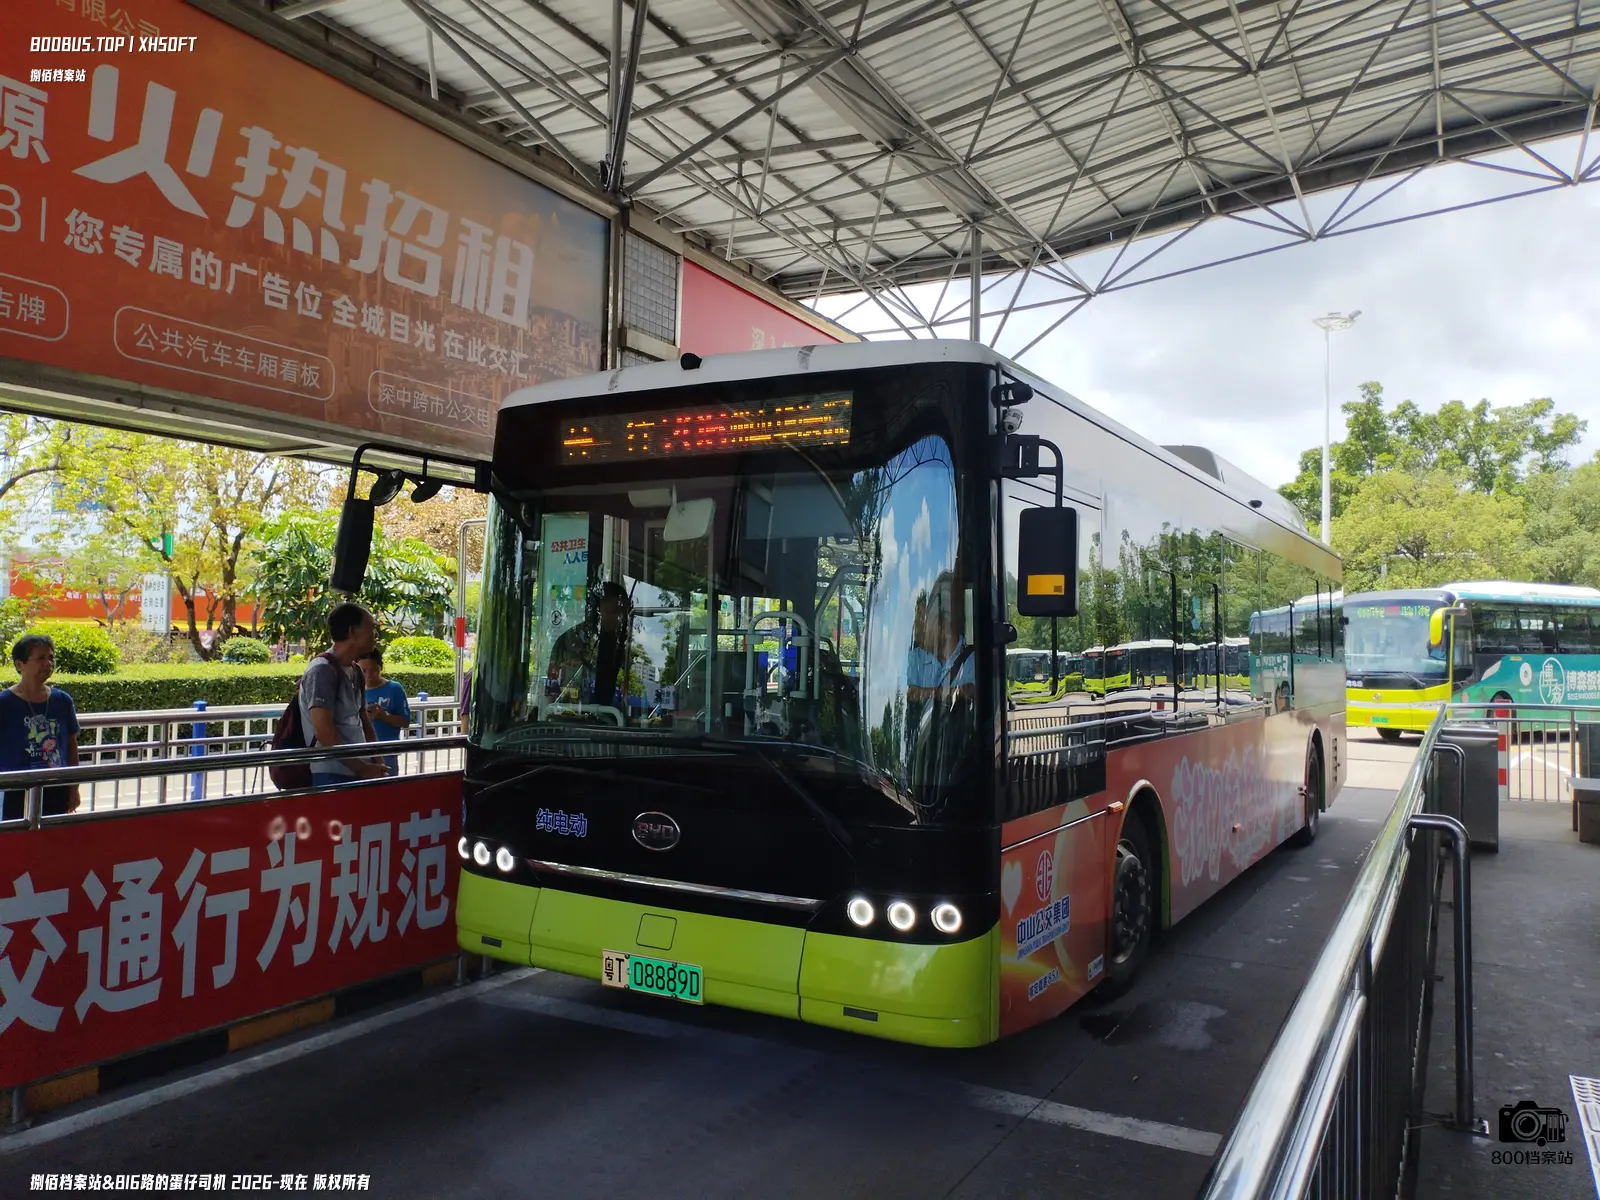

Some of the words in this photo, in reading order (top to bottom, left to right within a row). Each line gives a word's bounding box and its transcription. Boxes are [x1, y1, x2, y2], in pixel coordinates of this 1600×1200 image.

[71, 64, 536, 329] 火热招租
[63, 207, 324, 321] 您专属的广告位
[332, 295, 436, 352] 全城目光
[443, 329, 529, 379] 在此交汇
[133, 322, 321, 390] 公共汽车车厢看板
[378, 382, 500, 428] 深中跨市公交电
[536, 808, 588, 837] 纯电动
[637, 821, 674, 841] BYD
[0, 808, 451, 1034] 交通行为规范
[1017, 894, 1070, 946] 中山公交集团
